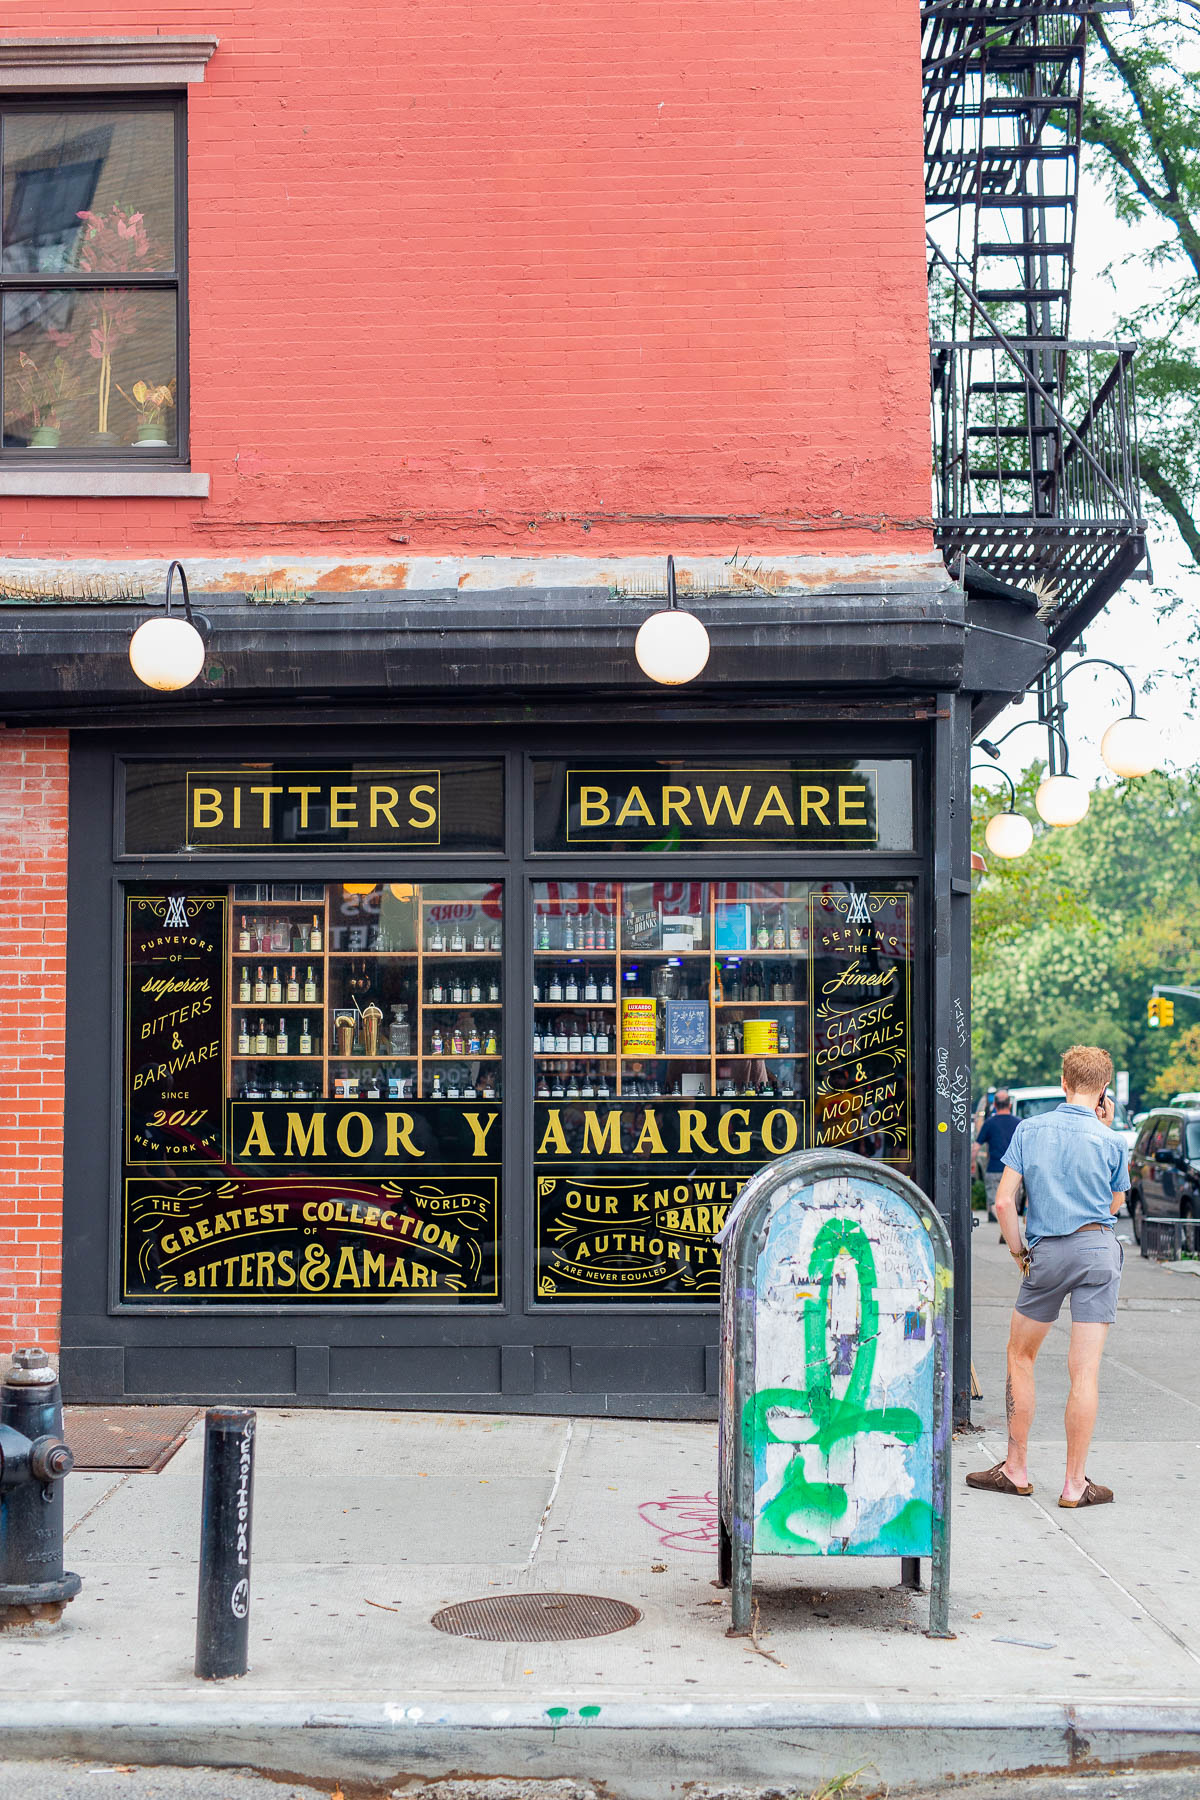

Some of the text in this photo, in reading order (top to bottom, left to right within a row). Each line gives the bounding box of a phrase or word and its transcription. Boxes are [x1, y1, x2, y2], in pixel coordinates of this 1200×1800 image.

[192, 784, 437, 830] BITTERS
[579, 785, 867, 827] BARWARE
[141, 936, 212, 951] PURVEYORS
[822, 928, 898, 946] SERVING
[169, 954, 182, 963] OF
[822, 960, 897, 995] finest
[141, 977, 209, 1001] superior
[142, 997, 212, 1039] BITTERS
[627, 1003, 652, 1011] LUXARDO
[826, 1003, 894, 1040] CLASSIC
[172, 1032, 183, 1050] &
[816, 1021, 904, 1066] COCKTAILS
[134, 1041, 218, 1090] BARWARE
[856, 1063, 867, 1081] &
[161, 1091, 190, 1100] SINCE
[822, 1082, 897, 1122] MODERN
[145, 1109, 209, 1127] 2011
[816, 1101, 904, 1146] MIXOLOGY
[240, 1109, 797, 1157] AMOR Y AMARGO
[134, 1134, 217, 1155] NEW YORK NY
[152, 1200, 180, 1212] THE
[416, 1198, 485, 1212] WORLD'S
[566, 1191, 618, 1213] OUR
[160, 1201, 459, 1254] GREATEST COLLECTION
[303, 1227, 318, 1236] OF
[184, 1244, 437, 1291] BITTERS & AMARI
[554, 1260, 666, 1280] & ARE NEVER EQUALED
